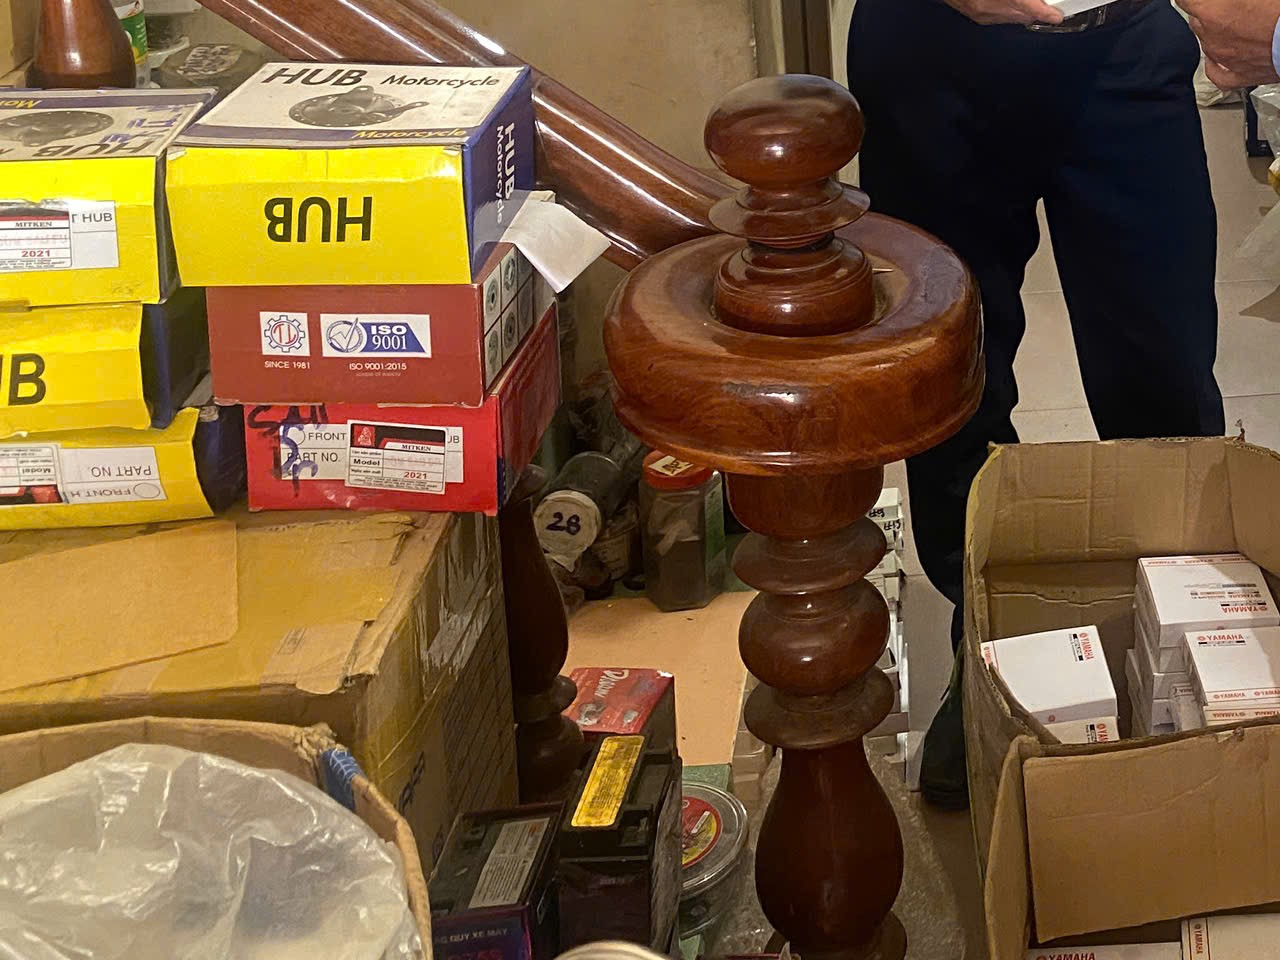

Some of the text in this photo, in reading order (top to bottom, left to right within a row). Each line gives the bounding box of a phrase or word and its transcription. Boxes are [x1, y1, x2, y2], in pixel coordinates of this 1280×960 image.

[261, 68, 500, 87] HUB Motorcycle
[352, 128, 467, 139] Motorcycle
[504, 122, 515, 200] HUB
[496, 125, 504, 224] Motorcycle
[82, 212, 113, 223] HUB
[264, 195, 373, 243] HUB
[21, 250, 51, 258] 2021
[370, 325, 407, 335] ISO
[371, 335, 408, 350] 9001
[264, 361, 290, 369] SINCE
[0, 352, 47, 406] B
[308, 432, 347, 441] FRONT
[401, 444, 432, 452] MITKEN
[353, 458, 380, 466] Model
[116, 467, 152, 476] PART
[403, 471, 428, 480] 2021
[85, 489, 132, 498] FRONT
[546, 511, 581, 536] 28
[1222, 606, 1254, 614] YAMAHA
[1206, 633, 1244, 641] YAMAHA
[1081, 637, 1095, 660] YAMAHA
